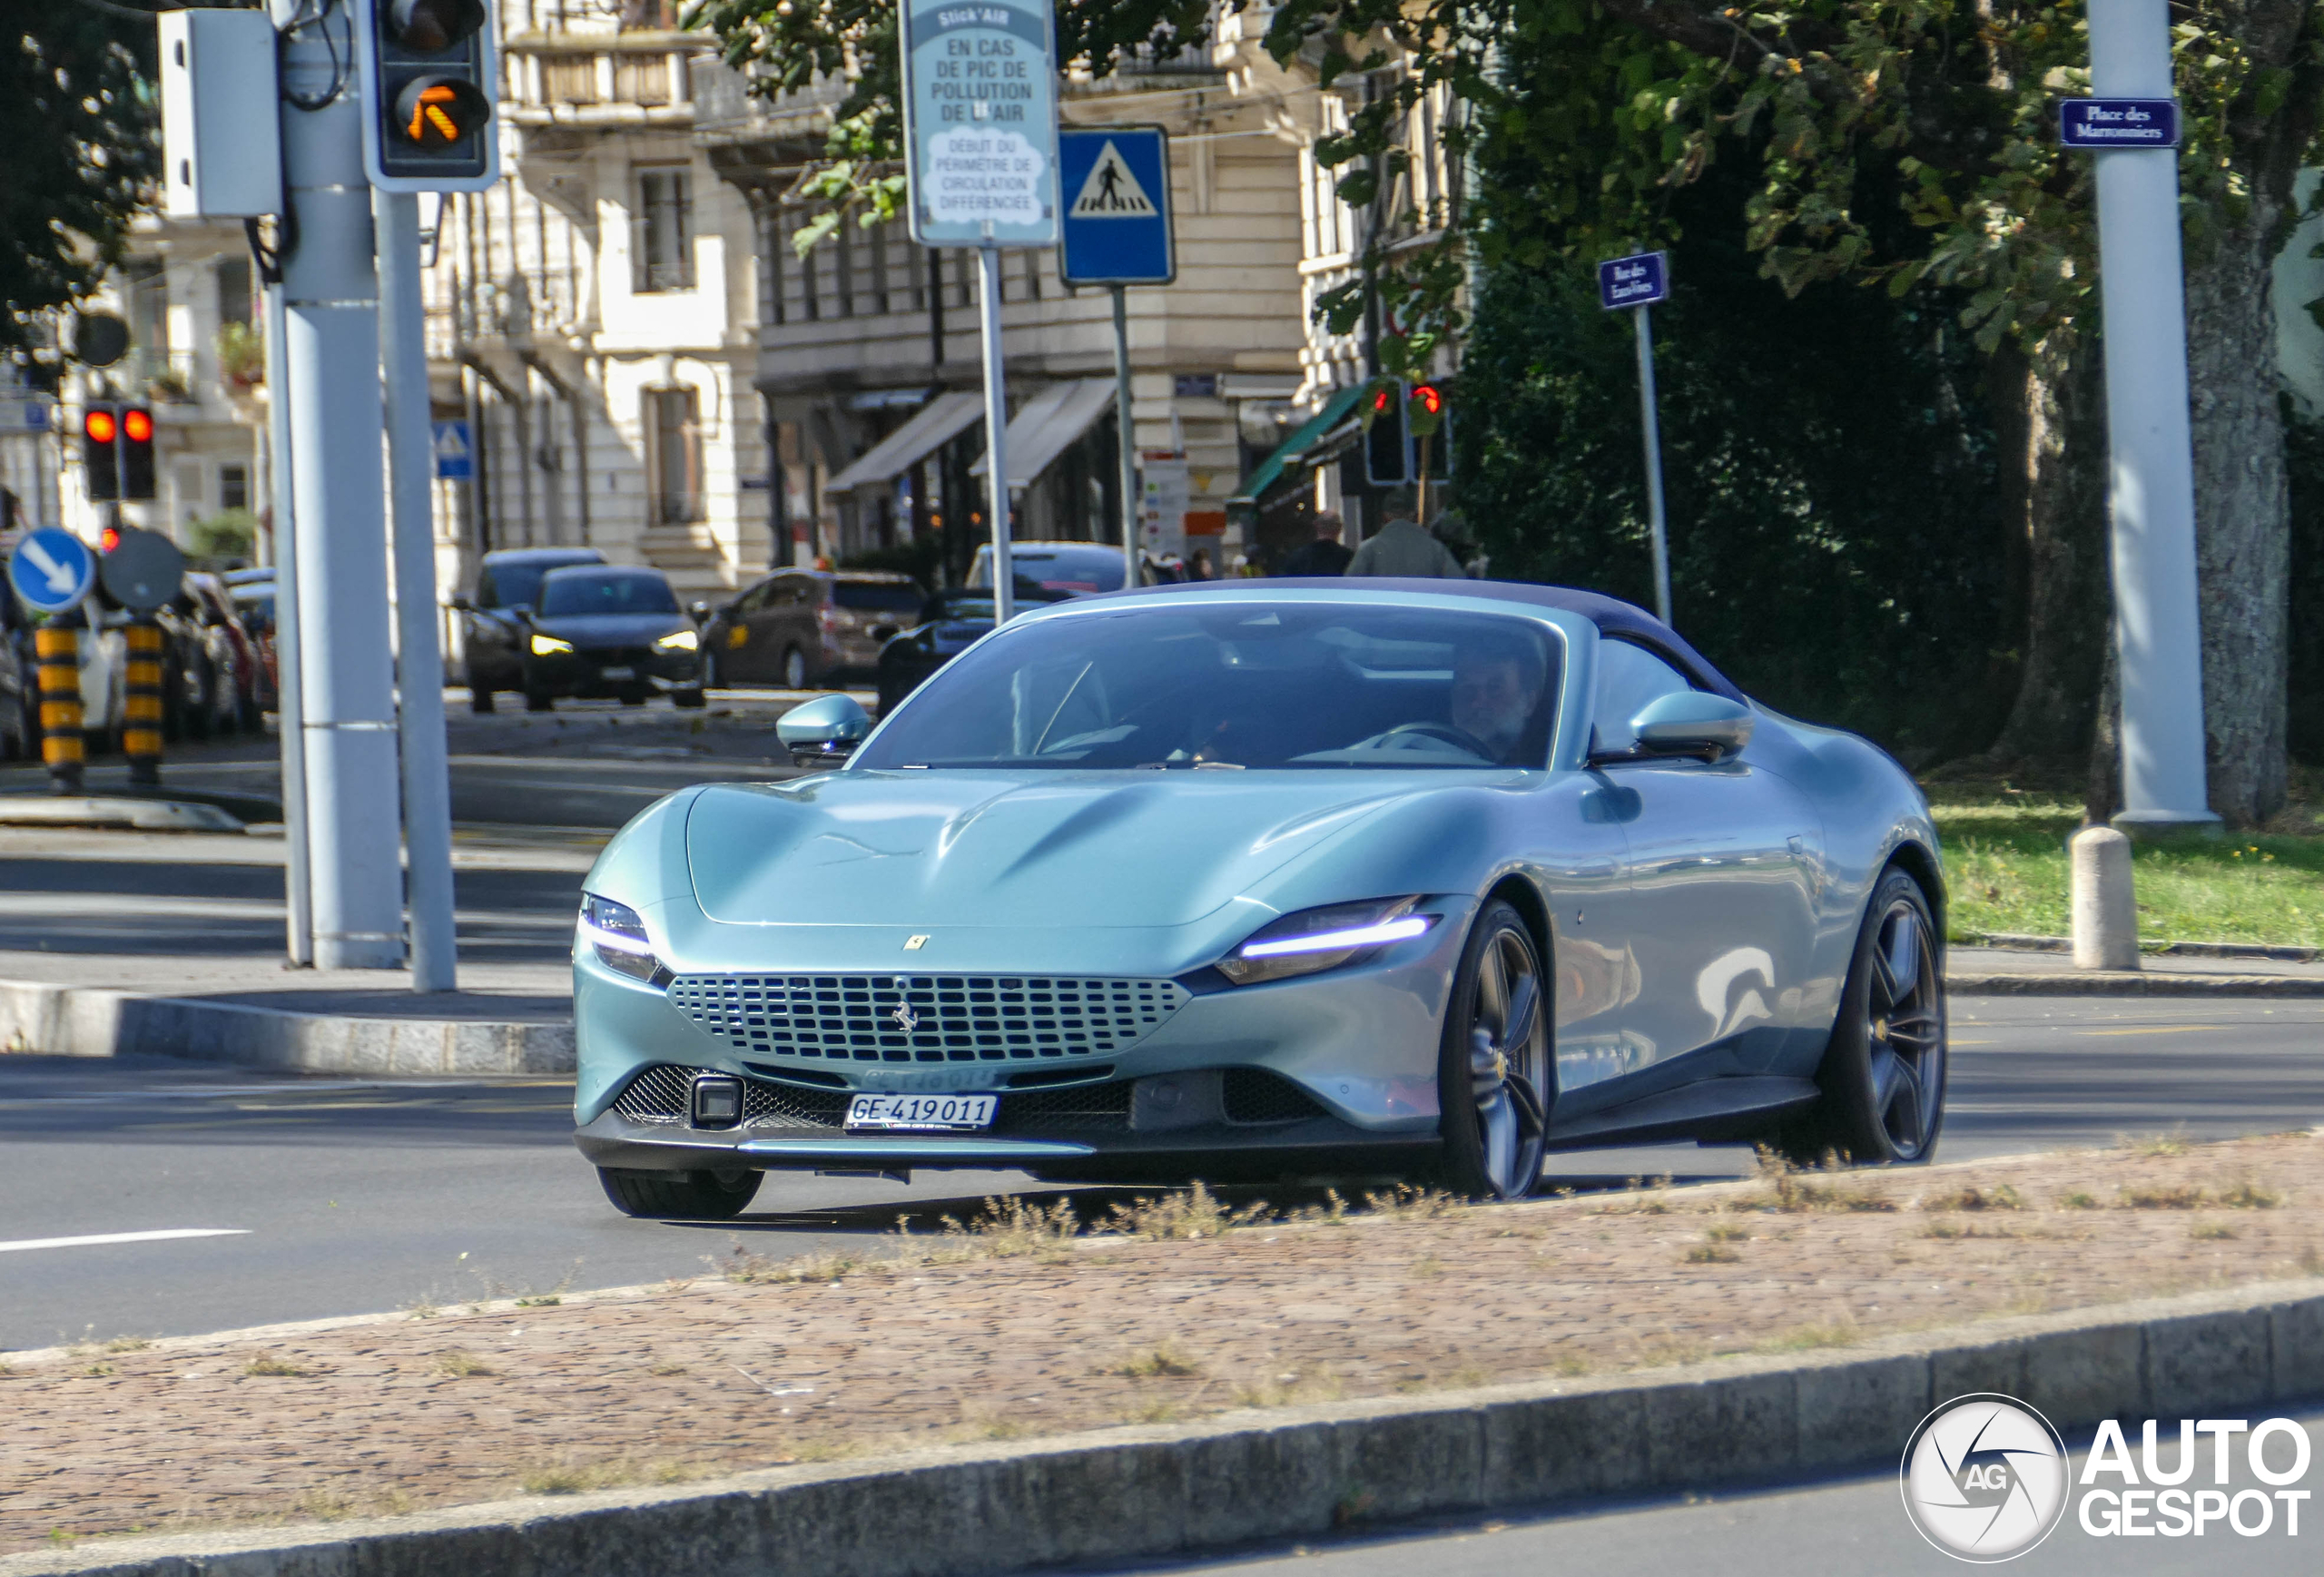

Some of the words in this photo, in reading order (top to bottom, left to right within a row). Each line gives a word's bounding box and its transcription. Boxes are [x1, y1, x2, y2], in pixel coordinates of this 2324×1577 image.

[938, 7, 1009, 27] Stick'AIR
[947, 39, 971, 55] EN
[978, 39, 1015, 55] CAS
[936, 60, 960, 78] DE
[967, 60, 997, 78] PIC
[1003, 61, 1027, 78] DE
[931, 83, 1032, 100] POLLUTION
[941, 104, 964, 122] DE
[2125, 106, 2152, 121] des
[949, 138, 991, 153] DÉBUT
[997, 140, 1016, 153] DU
[935, 156, 1009, 172] PÉRIMÈTRE
[1013, 158, 1031, 172] DE
[941, 177, 1027, 191] CIRCULATION
[939, 194, 1031, 210] DIFFÉRENCIÉE
